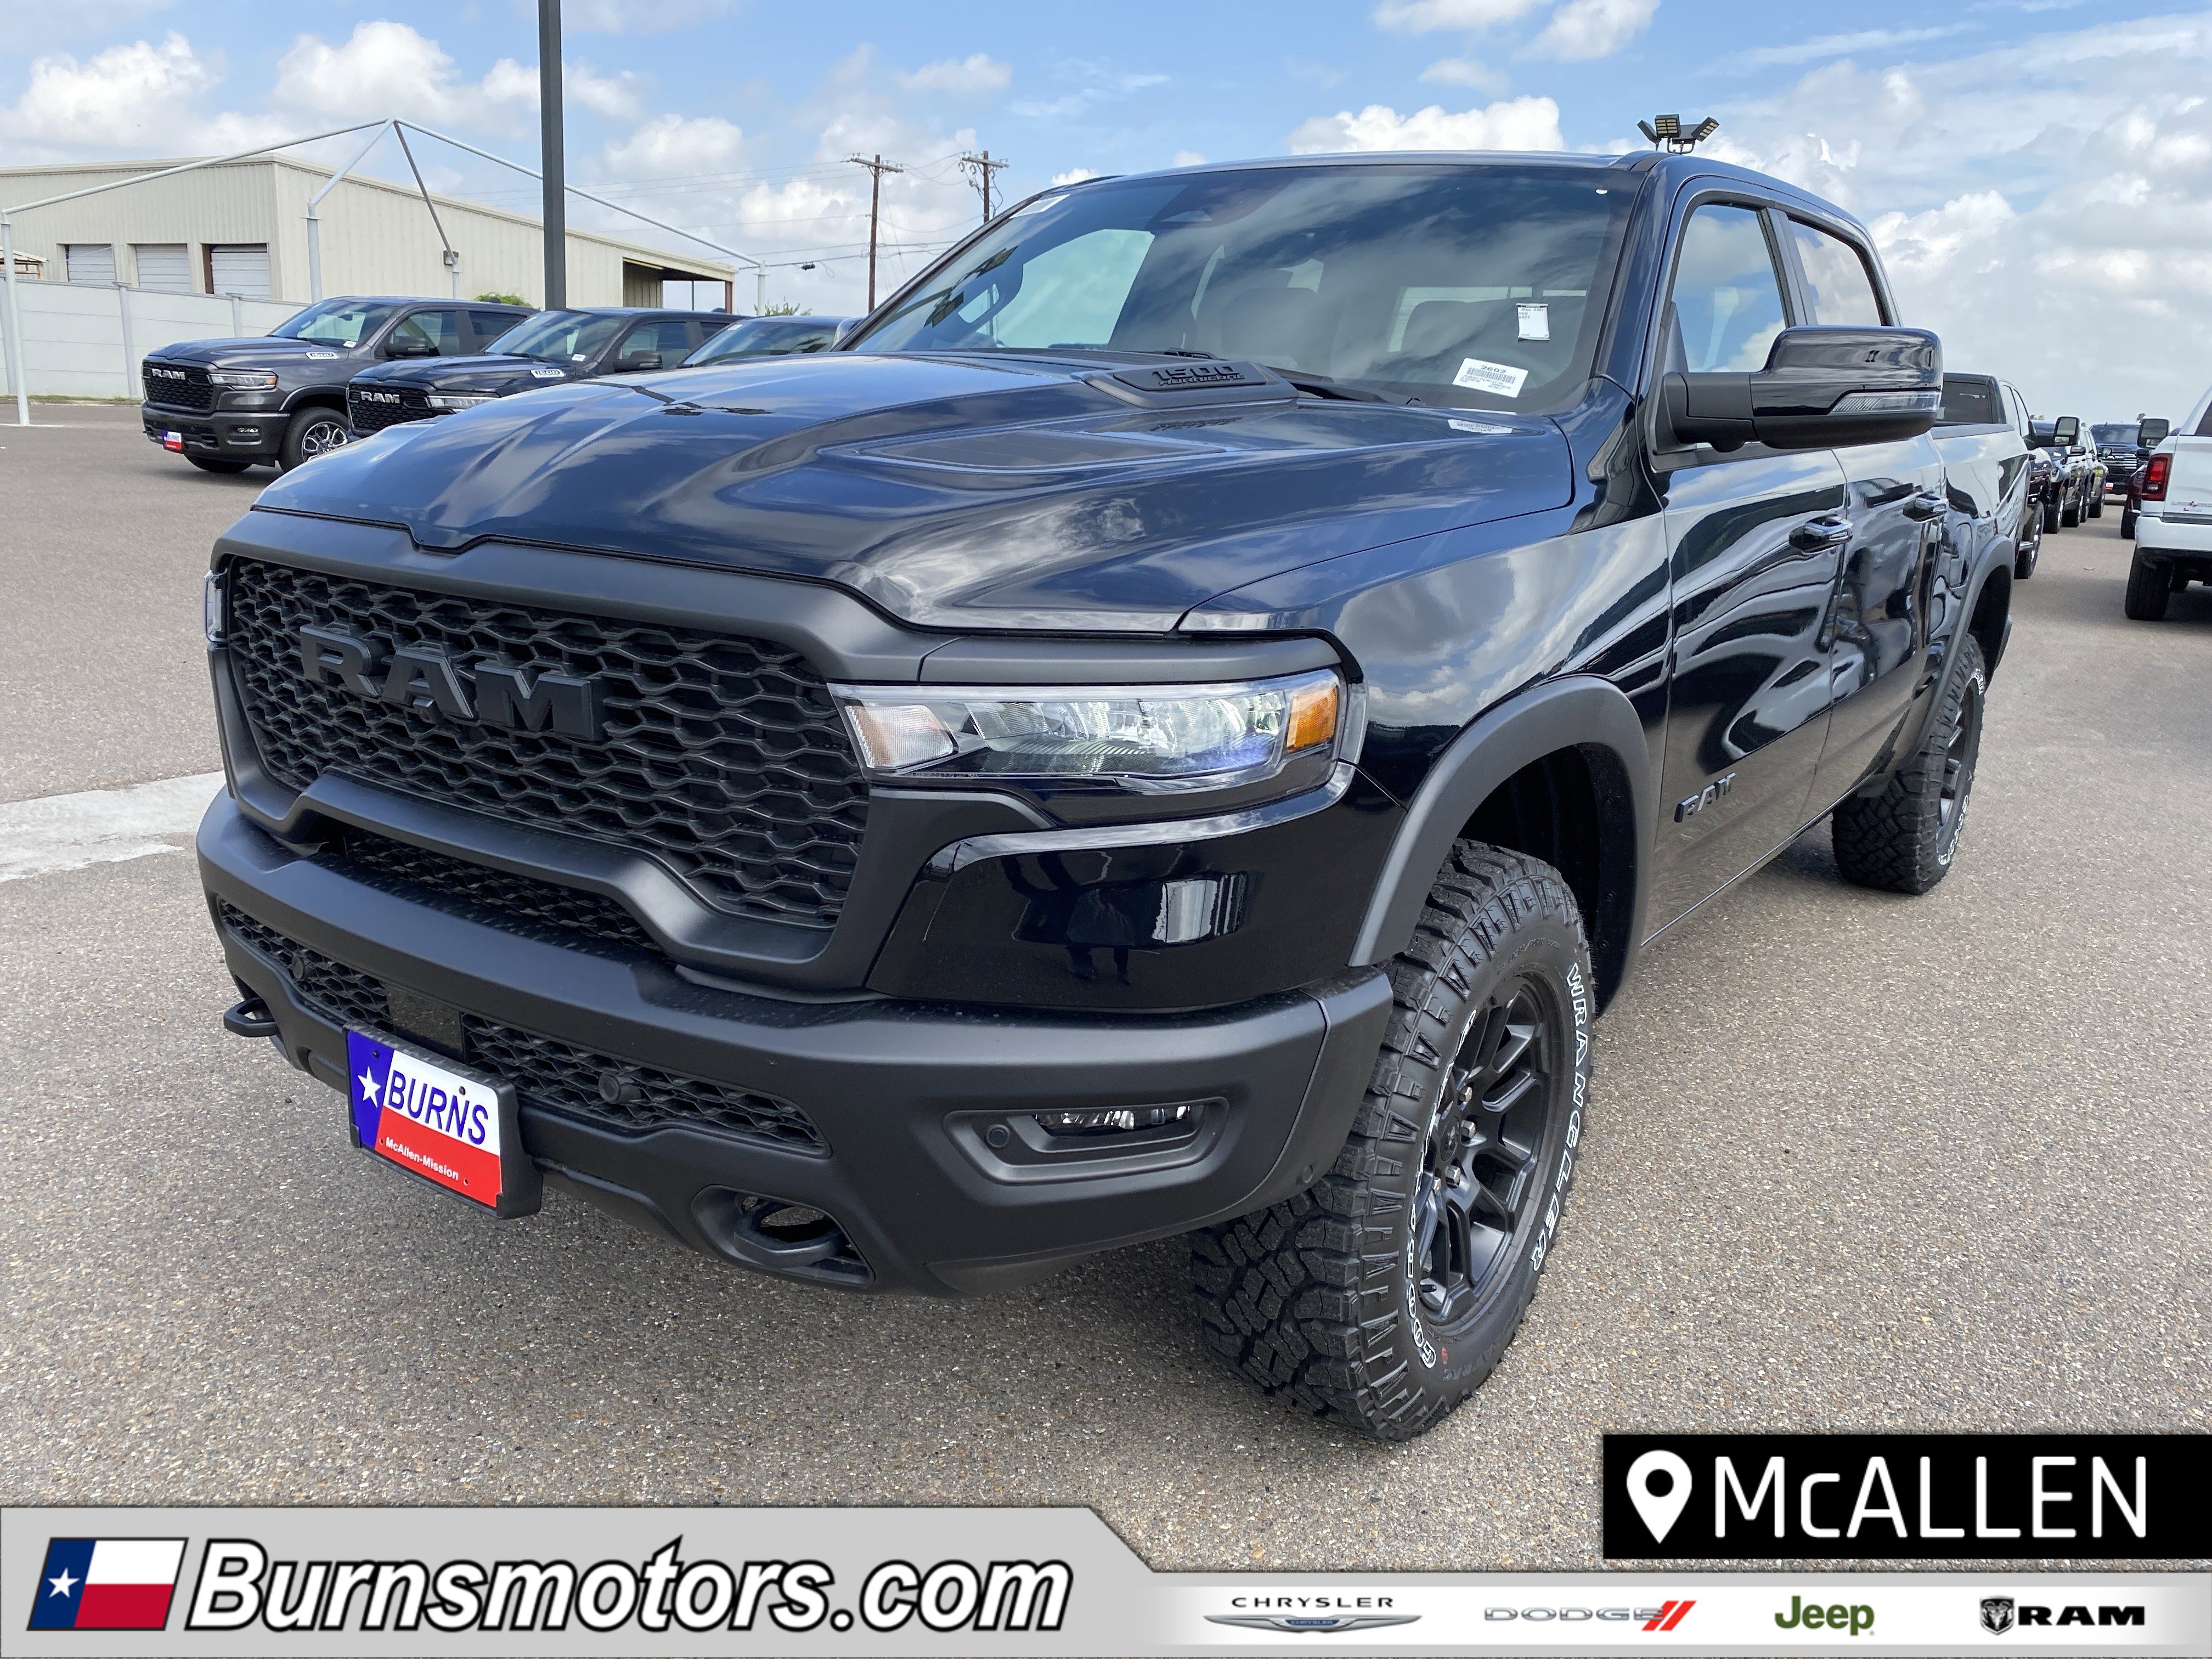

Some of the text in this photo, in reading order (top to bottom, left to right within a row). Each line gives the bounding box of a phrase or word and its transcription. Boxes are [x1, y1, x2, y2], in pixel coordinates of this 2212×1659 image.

[151, 368, 186, 380] RAM
[1153, 366, 1241, 381] 1500
[1480, 365, 1507, 374] 2602
[1159, 375, 1246, 386] HURRICANE
[360, 391, 400, 404] RAM
[300, 624, 598, 742] RAM
[388, 1070, 488, 1145] BURNS
[1531, 962, 1588, 1271] WRANGLER
[385, 1136, 459, 1181] McAllen-Mission
